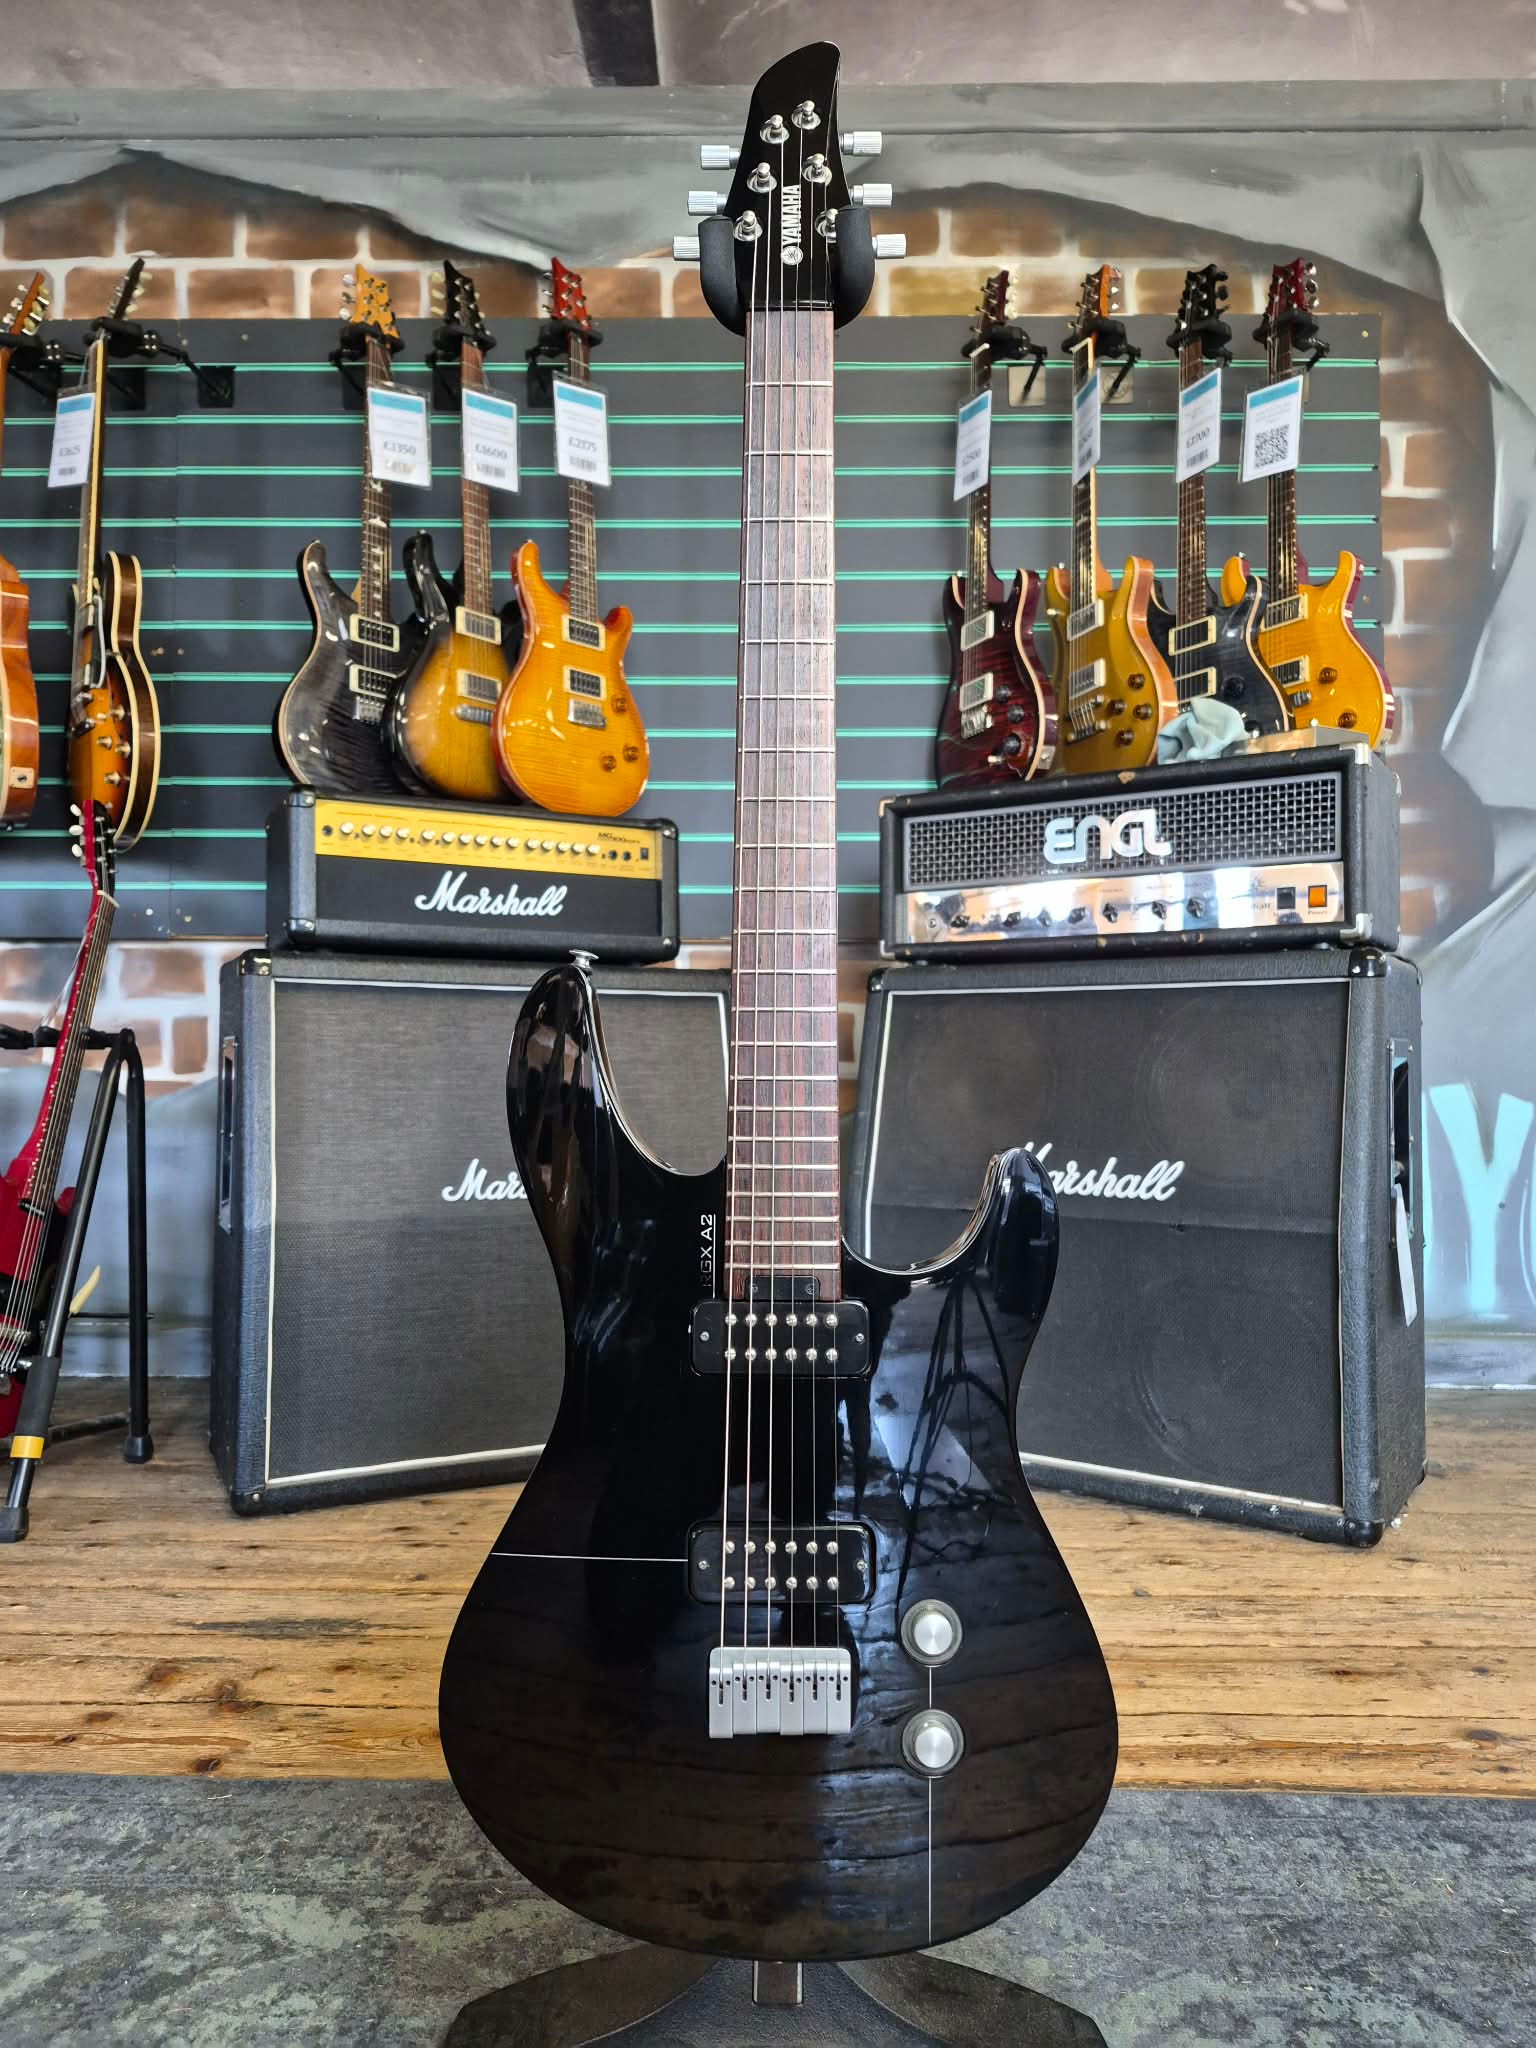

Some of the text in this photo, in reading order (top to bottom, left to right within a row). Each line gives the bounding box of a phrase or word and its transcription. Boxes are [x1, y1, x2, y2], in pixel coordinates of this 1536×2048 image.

[782, 184, 801, 248] YAMAHA
[1043, 808, 1172, 864] ENGL
[414, 870, 568, 916] Marshall
[700, 1214, 713, 1241] A2
